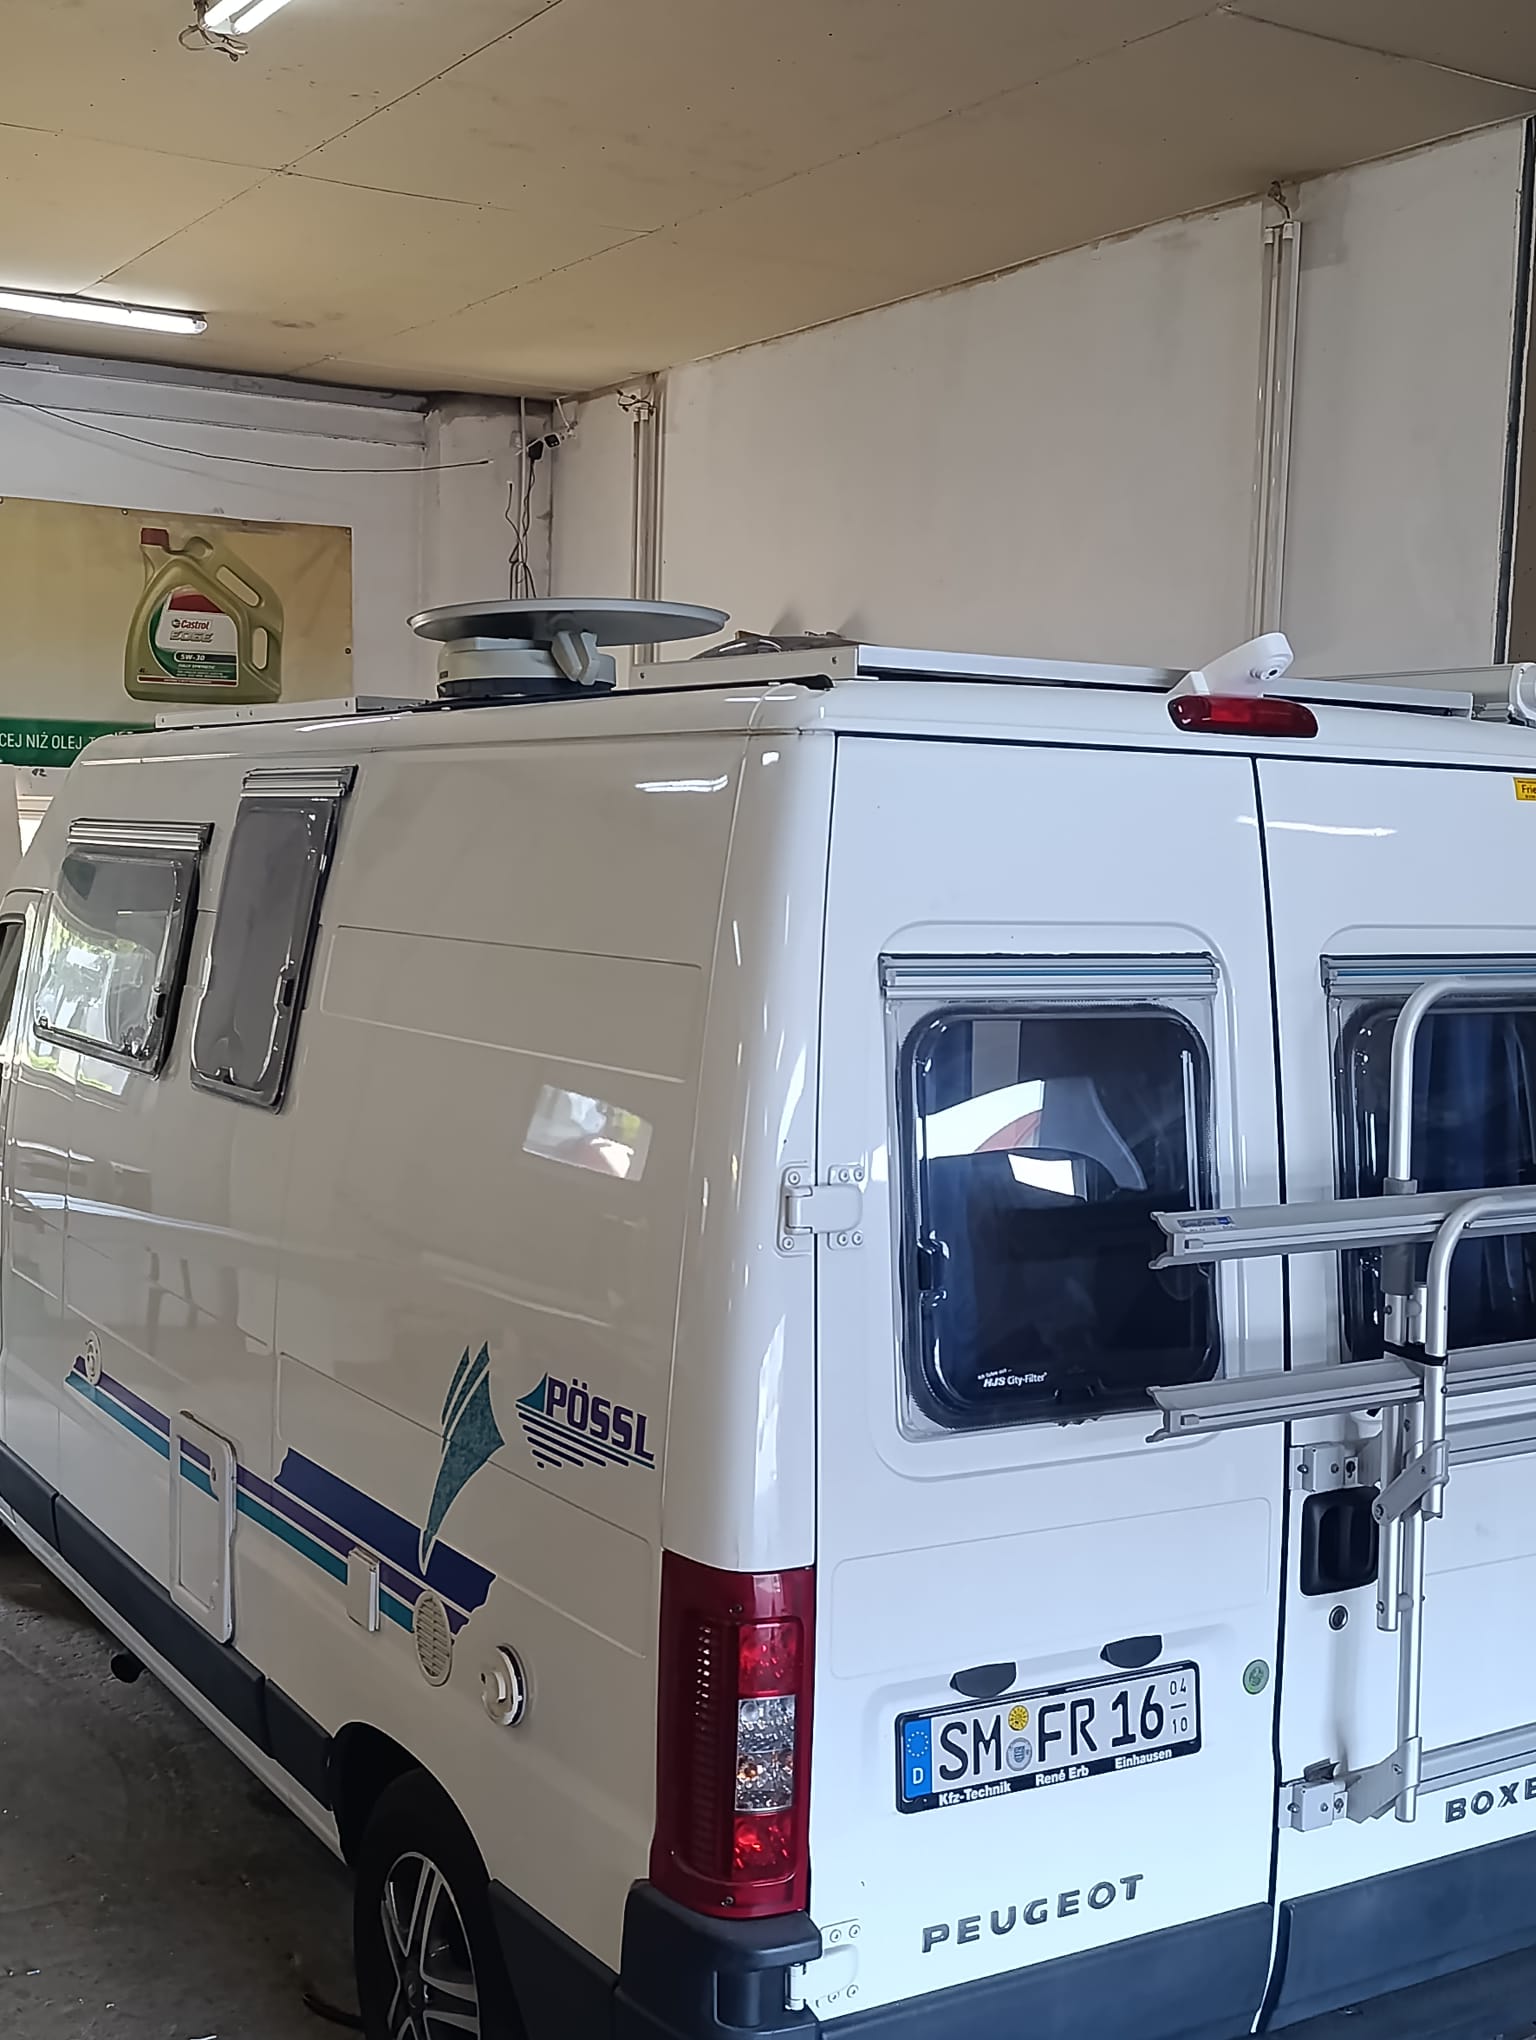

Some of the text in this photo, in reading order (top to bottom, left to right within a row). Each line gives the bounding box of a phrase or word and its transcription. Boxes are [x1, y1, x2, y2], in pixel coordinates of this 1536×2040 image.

[181, 619, 210, 630] Castrol
[180, 653, 206, 661] 5W-30
[26, 731, 49, 749] NIŻ
[51, 735, 82, 750] OLEJ
[983, 1376, 1006, 1388] HJS
[546, 1376, 655, 1461] PÖSSL
[1169, 1677, 1187, 1696] 04
[939, 1684, 1164, 1781] SM FR 16
[1172, 1716, 1188, 1734] 10
[912, 1767, 924, 1785] D
[938, 1748, 1173, 1807] Kfz-Technik René Erb Einhausen
[1445, 1776, 1536, 1823] BOXE
[922, 1874, 1144, 1953] PEUGEOT
